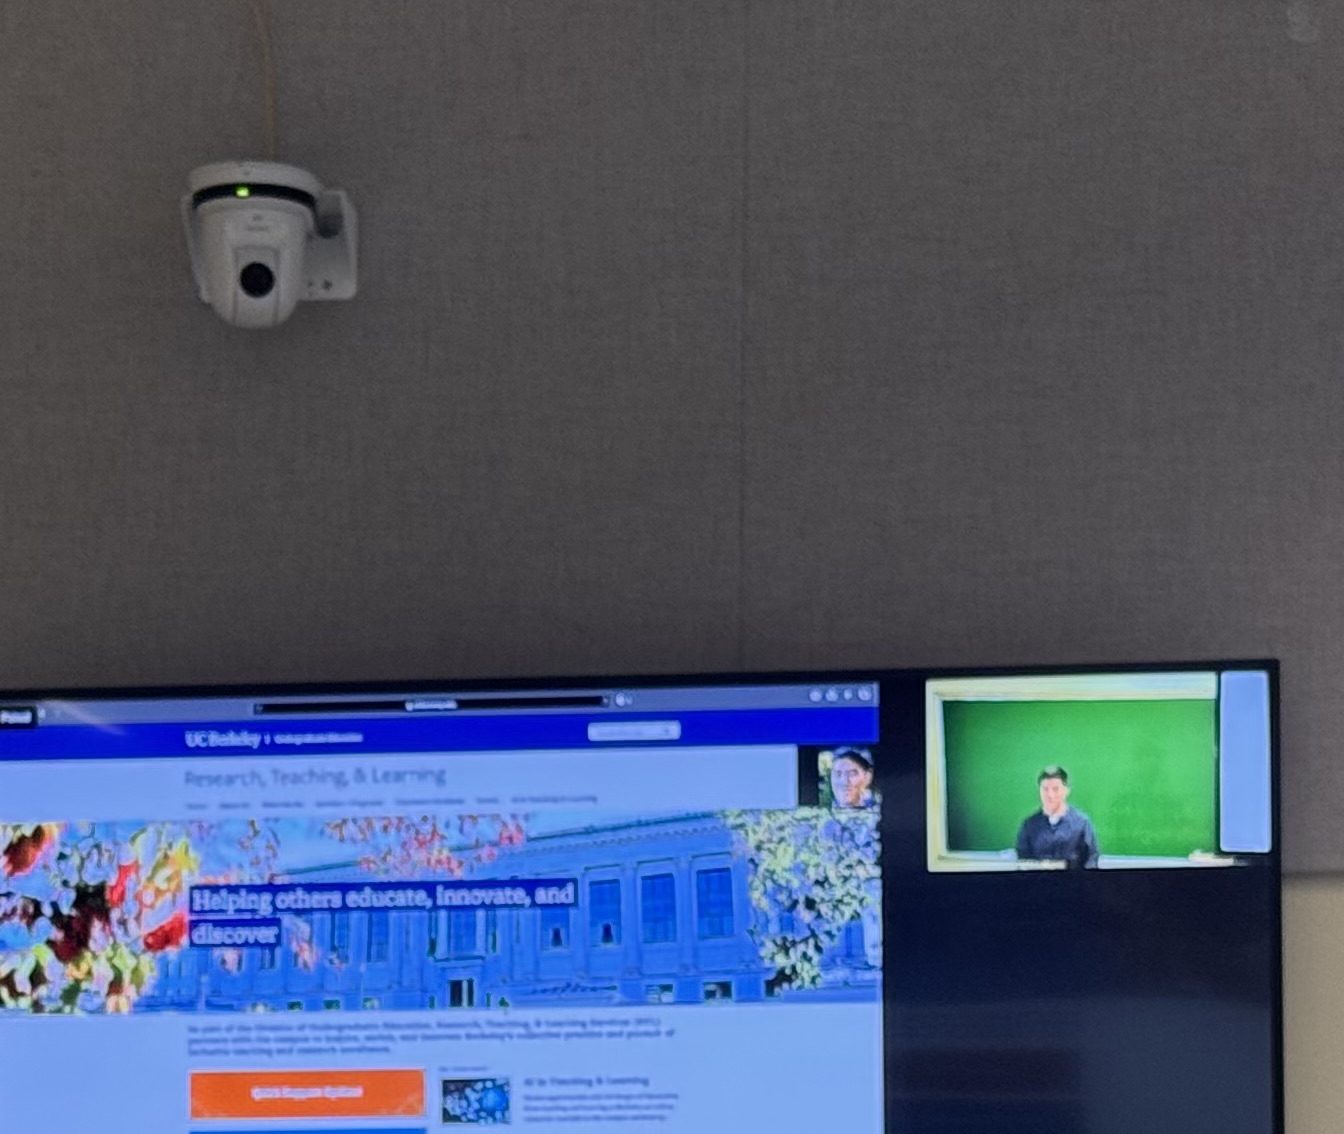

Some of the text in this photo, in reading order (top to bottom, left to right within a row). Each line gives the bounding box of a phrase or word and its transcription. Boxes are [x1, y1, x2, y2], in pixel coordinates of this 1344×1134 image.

[185, 730, 207, 748] UC
[185, 770, 266, 787] Research,
[270, 767, 350, 786] Teaching,
[372, 766, 446, 786] Learning
[191, 883, 575, 915] Helping others educate, innovate, and
[191, 921, 279, 945] discover
